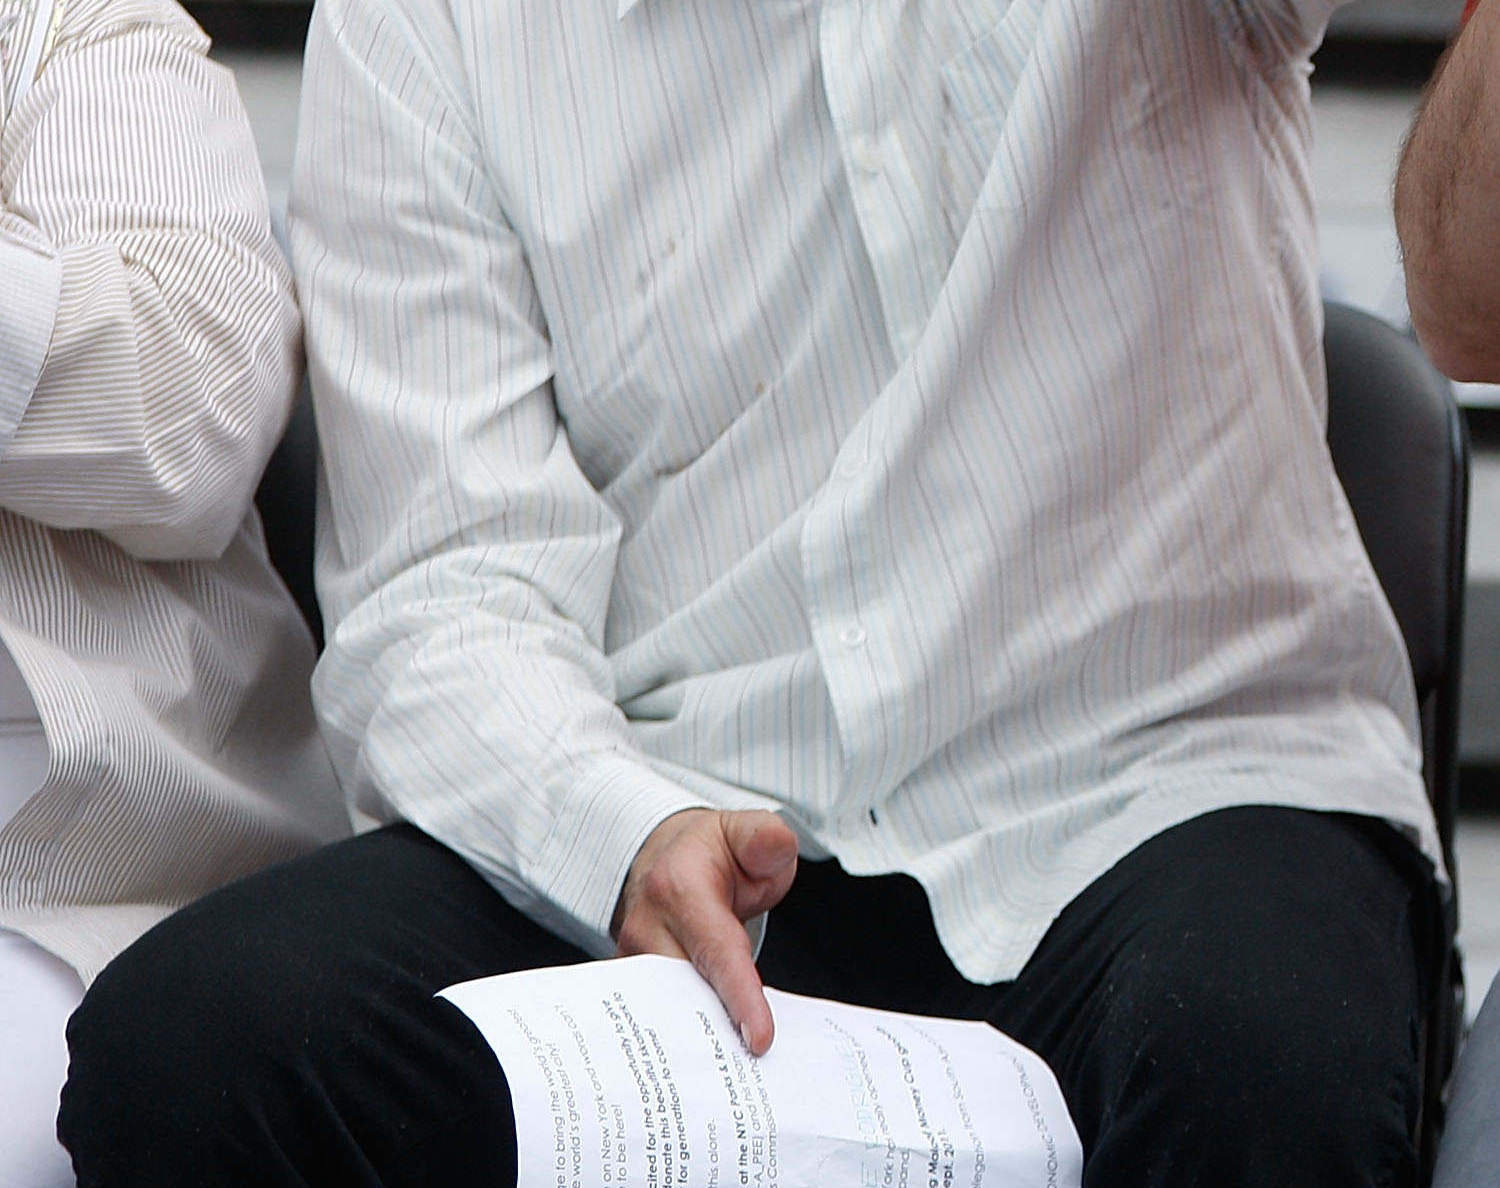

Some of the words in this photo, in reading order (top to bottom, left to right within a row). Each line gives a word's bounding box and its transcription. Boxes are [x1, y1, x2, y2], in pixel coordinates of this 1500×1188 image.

[615, 1023, 625, 1034] to
[643, 1028, 667, 1064] come!
[711, 1038, 726, 1060] Rec
[533, 1046, 555, 1088] world's
[584, 1067, 602, 1092] and
[620, 1036, 651, 1104] opportunity
[662, 1067, 671, 1079] to
[719, 1064, 729, 1073] &
[902, 1058, 914, 1083] Cup
[556, 1070, 581, 1122] greatest
[641, 1061, 666, 1113] beautiful
[723, 1076, 740, 1107] Parks
[550, 1090, 561, 1112] the
[594, 1093, 608, 1123] York
[611, 1104, 625, 1139] here!
[643, 1107, 655, 1128] the
[659, 1117, 671, 1140] this
[667, 1083, 690, 1161] generations
[733, 1110, 747, 1139] NYC
[745, 1104, 761, 1131] and
[553, 1116, 566, 1152] bring
[601, 1126, 612, 1160] New
[645, 1131, 656, 1151] for
[756, 1087, 778, 1179] Commissioner
[554, 1156, 566, 1170] to
[569, 1125, 581, 1177] world's
[615, 1143, 626, 1163] be
[737, 1144, 748, 1167] the
[602, 1164, 612, 1182] on
[616, 1166, 627, 1181] to
[677, 1165, 688, 1183] for
[738, 1170, 749, 1185] at
